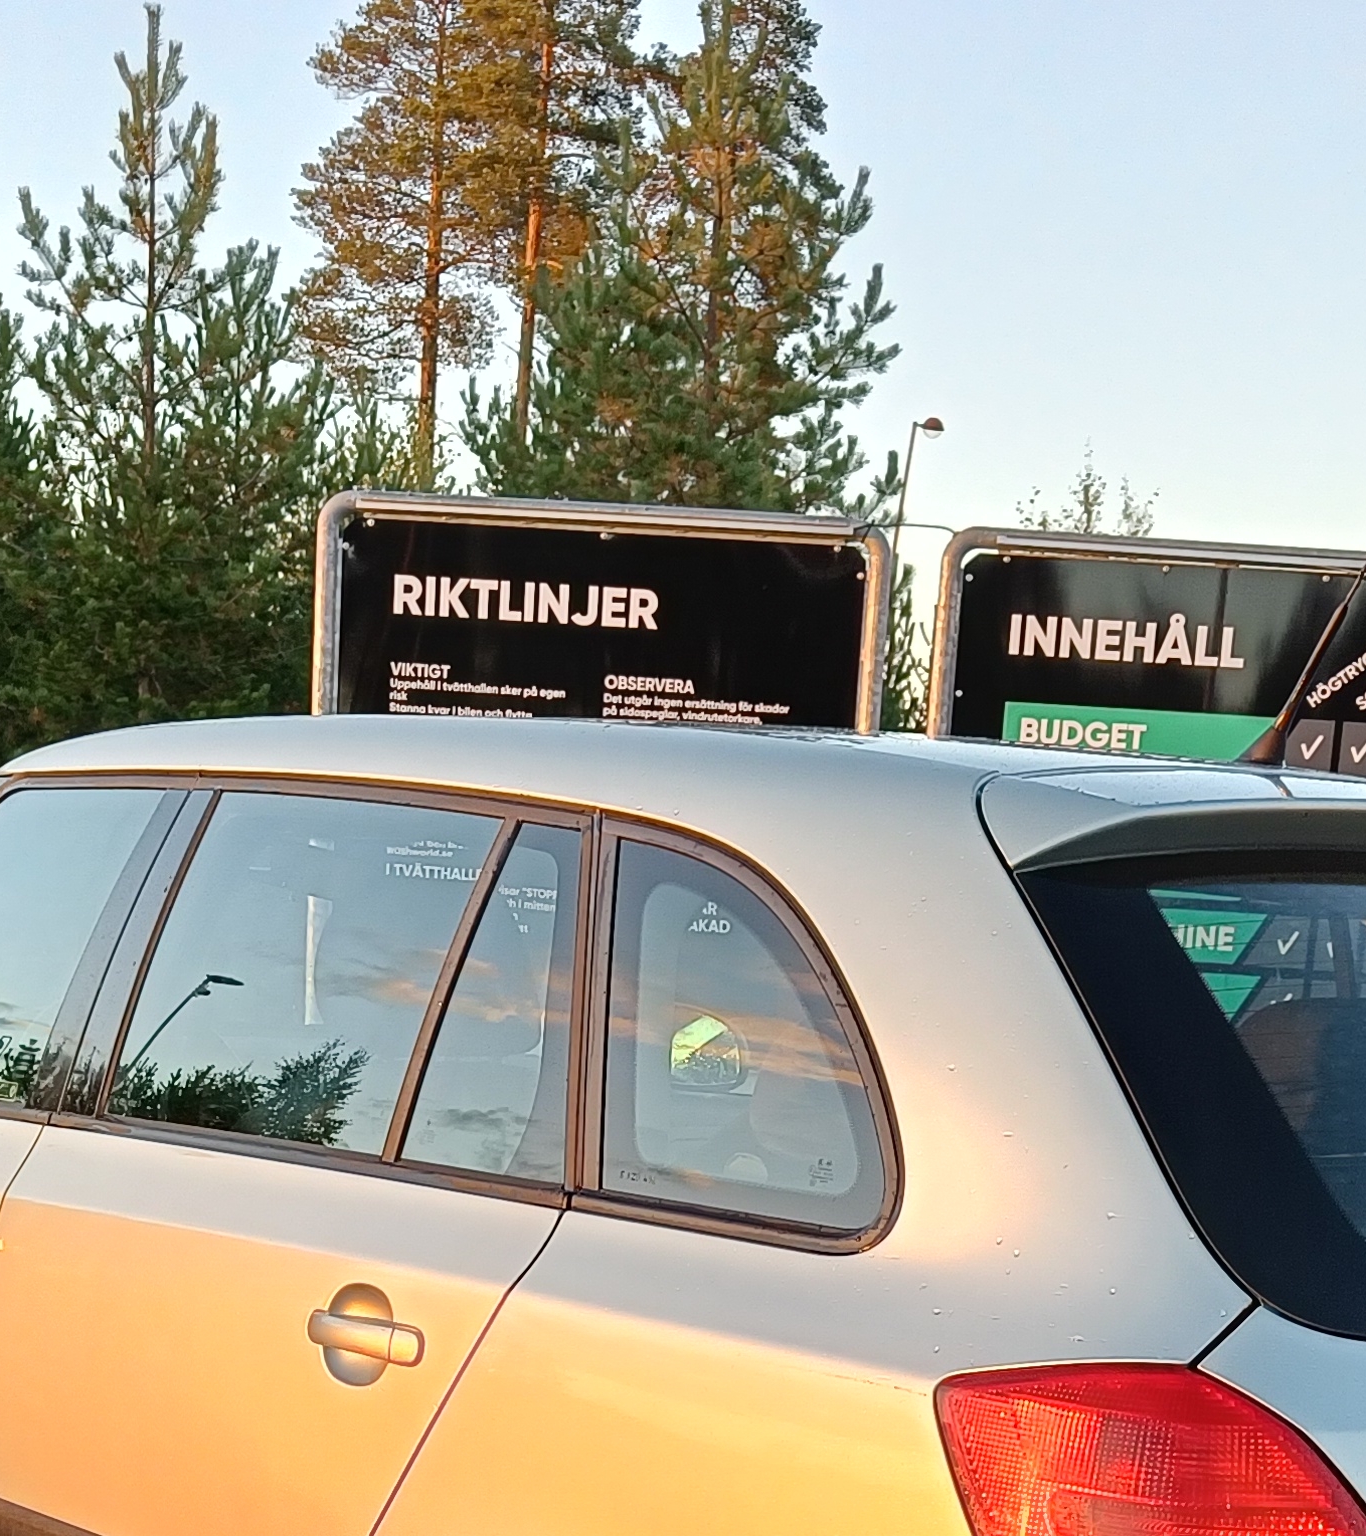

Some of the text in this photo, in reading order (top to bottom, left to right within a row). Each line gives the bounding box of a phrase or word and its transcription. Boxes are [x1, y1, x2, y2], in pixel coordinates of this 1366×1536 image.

[393, 574, 659, 630] RIKTLINJER
[1008, 613, 1245, 669] INNEHÅLL
[390, 661, 451, 679] VIKTIGT
[389, 678, 436, 691] Uppehåll
[442, 682, 499, 695] tvätthallen
[500, 685, 522, 696] sker
[523, 686, 538, 698] på
[539, 689, 566, 700] egen
[604, 675, 695, 694] OBSERVERA
[389, 690, 408, 701] risk
[603, 693, 790, 714] Det utgår ingen ersättning för skador
[389, 702, 426, 713] Stanna
[428, 704, 451, 715] kvar
[457, 707, 482, 717] bilen
[485, 709, 503, 718] och
[602, 705, 618, 717] på
[1019, 717, 1147, 750] BUDGET
